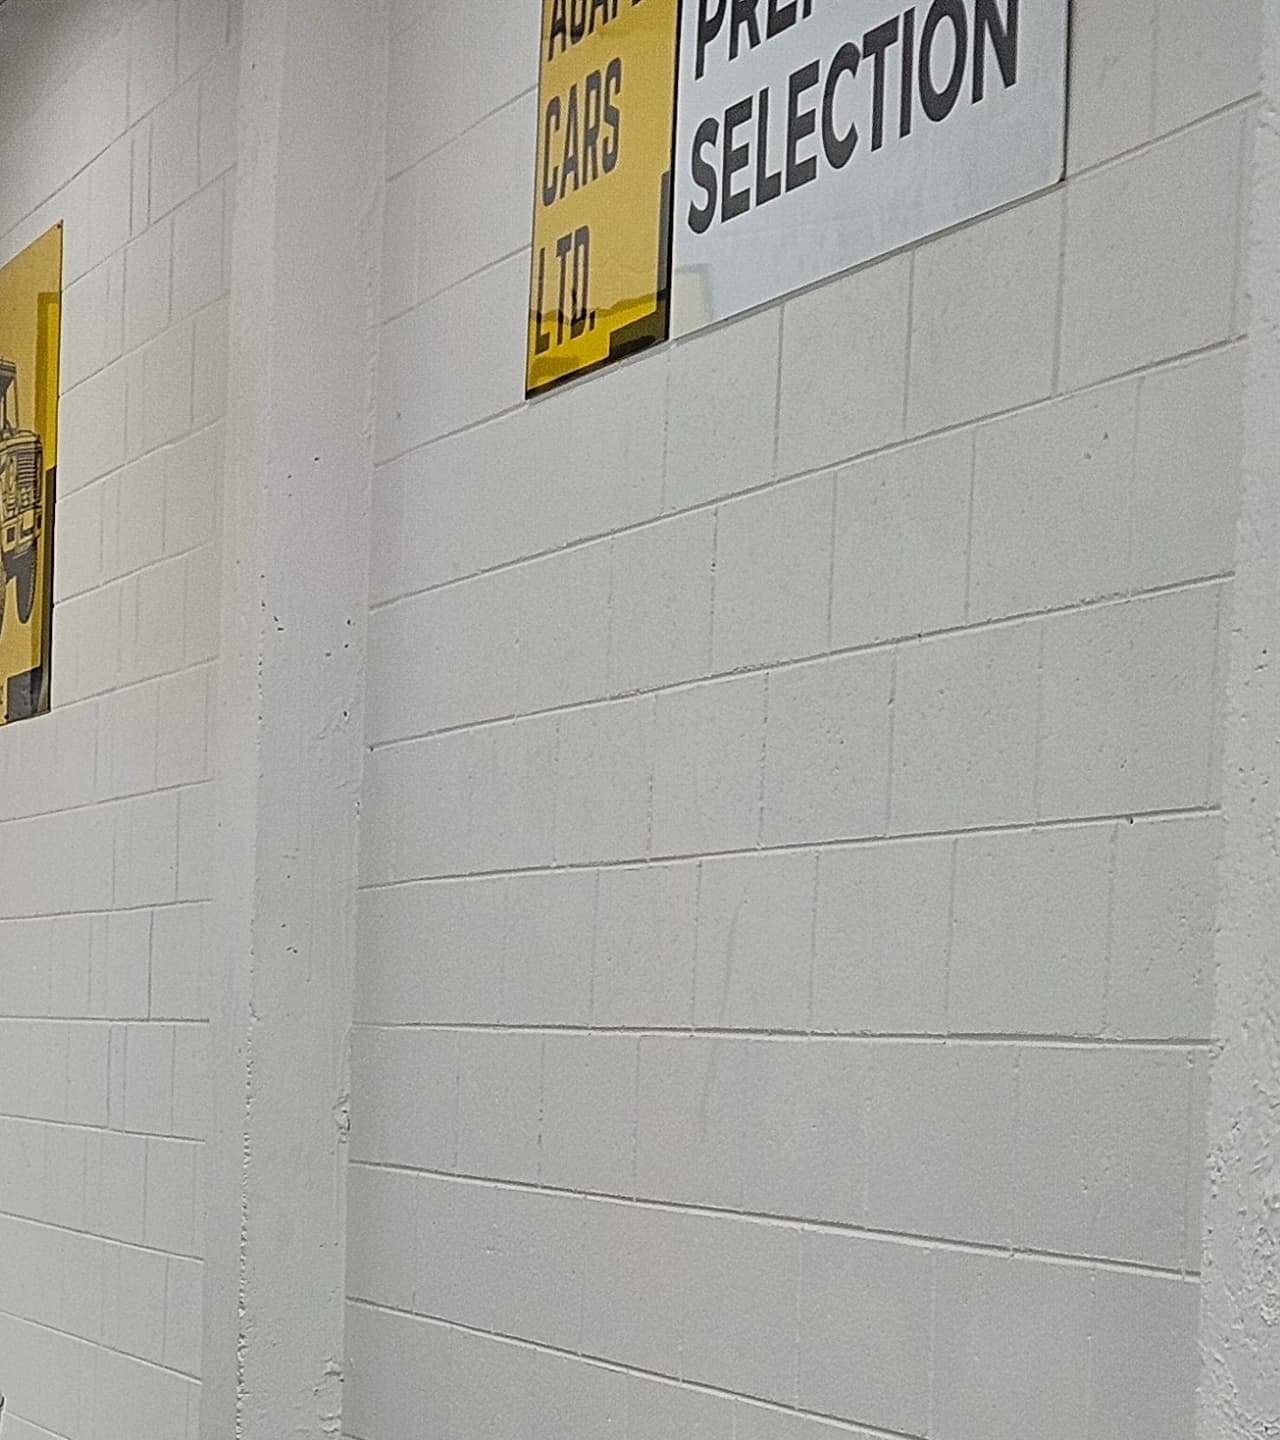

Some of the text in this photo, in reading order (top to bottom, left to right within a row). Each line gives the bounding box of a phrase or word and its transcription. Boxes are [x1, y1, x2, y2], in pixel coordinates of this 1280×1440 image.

[541, 56, 623, 208] CARS
[686, 0, 1018, 235] SELECTION
[534, 224, 597, 356] LTD.
